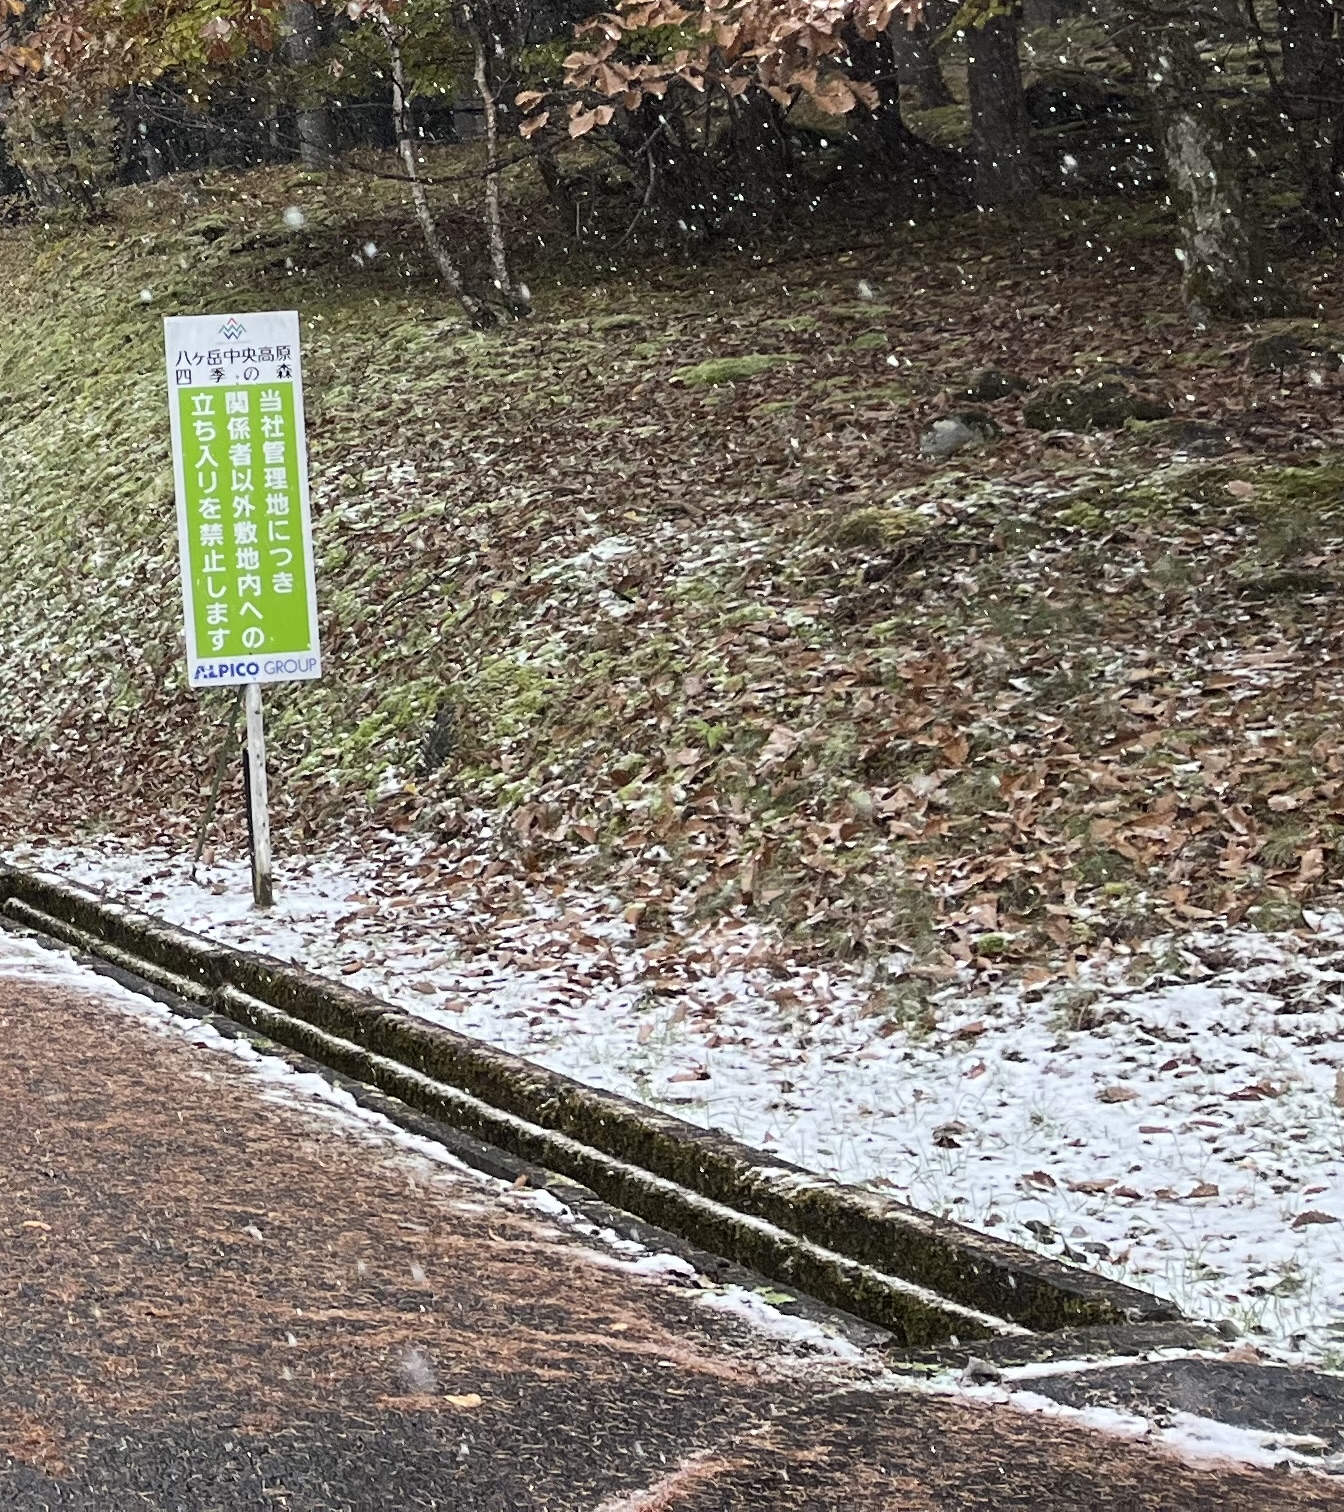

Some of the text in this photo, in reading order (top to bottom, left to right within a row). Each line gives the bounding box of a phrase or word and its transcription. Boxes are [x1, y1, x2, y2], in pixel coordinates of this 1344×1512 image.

[175, 344, 292, 367] 八ヶ岳中央高原
[175, 363, 293, 385] 四季の森
[190, 393, 230, 651] 立ち入りを禁止します
[225, 390, 265, 649] 関係者以外敷地内への
[258, 388, 294, 594] 当社管理地につき
[194, 658, 317, 679] ALPICO GROUP
